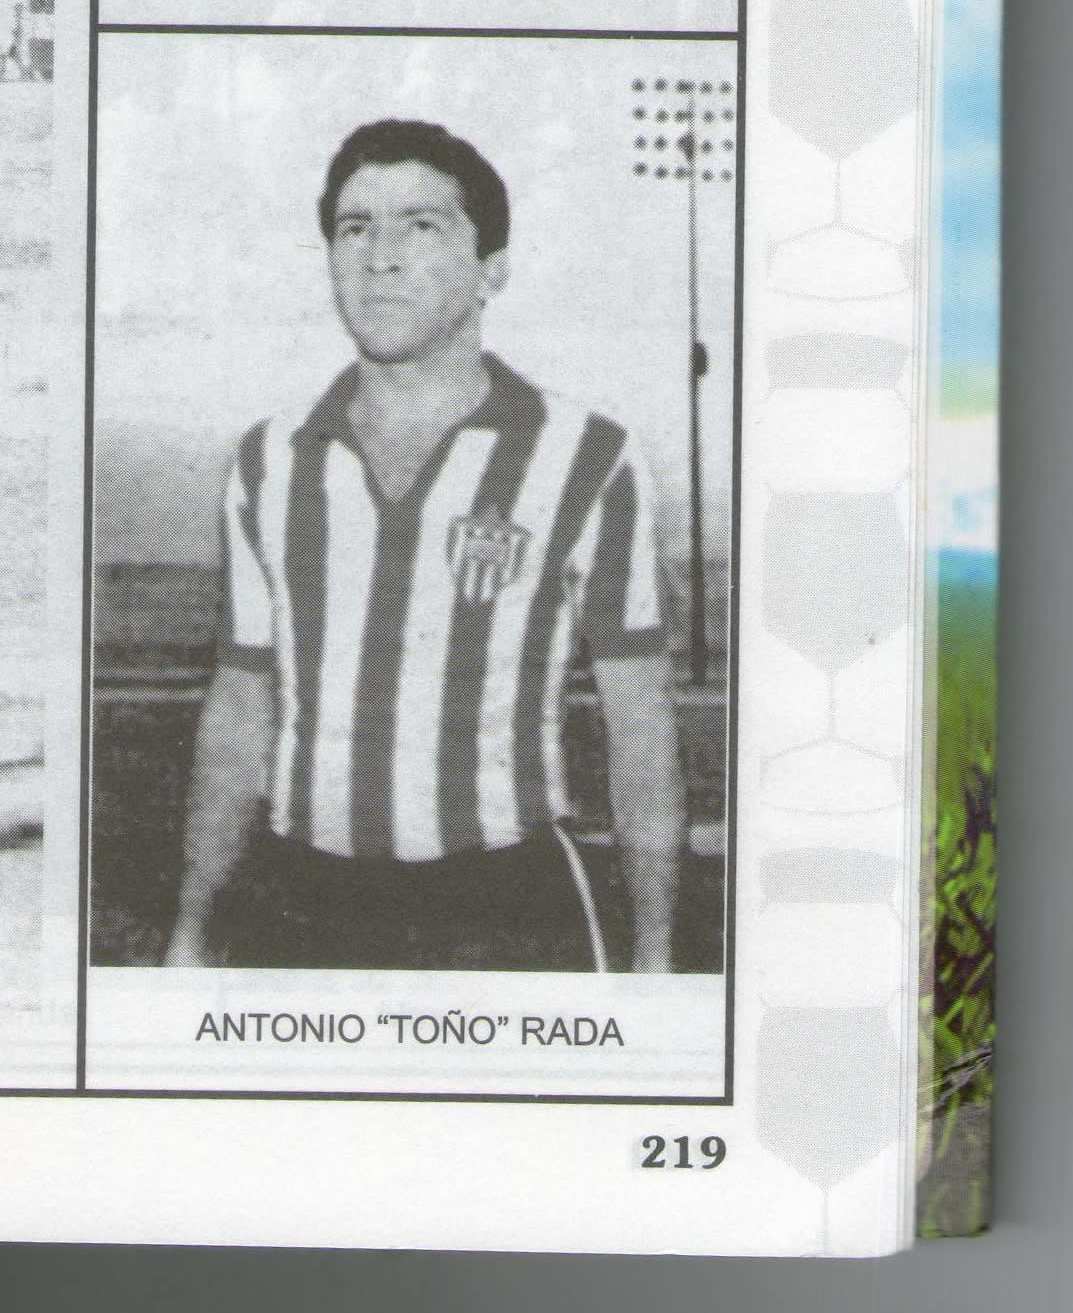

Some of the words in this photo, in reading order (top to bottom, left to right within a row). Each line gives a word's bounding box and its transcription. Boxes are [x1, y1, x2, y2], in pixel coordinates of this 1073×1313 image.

[194, 1012, 366, 1045] ANTONIO
[376, 1009, 510, 1046] “TOÑO”
[520, 1016, 626, 1047] RADA
[640, 1135, 728, 1170] 219
